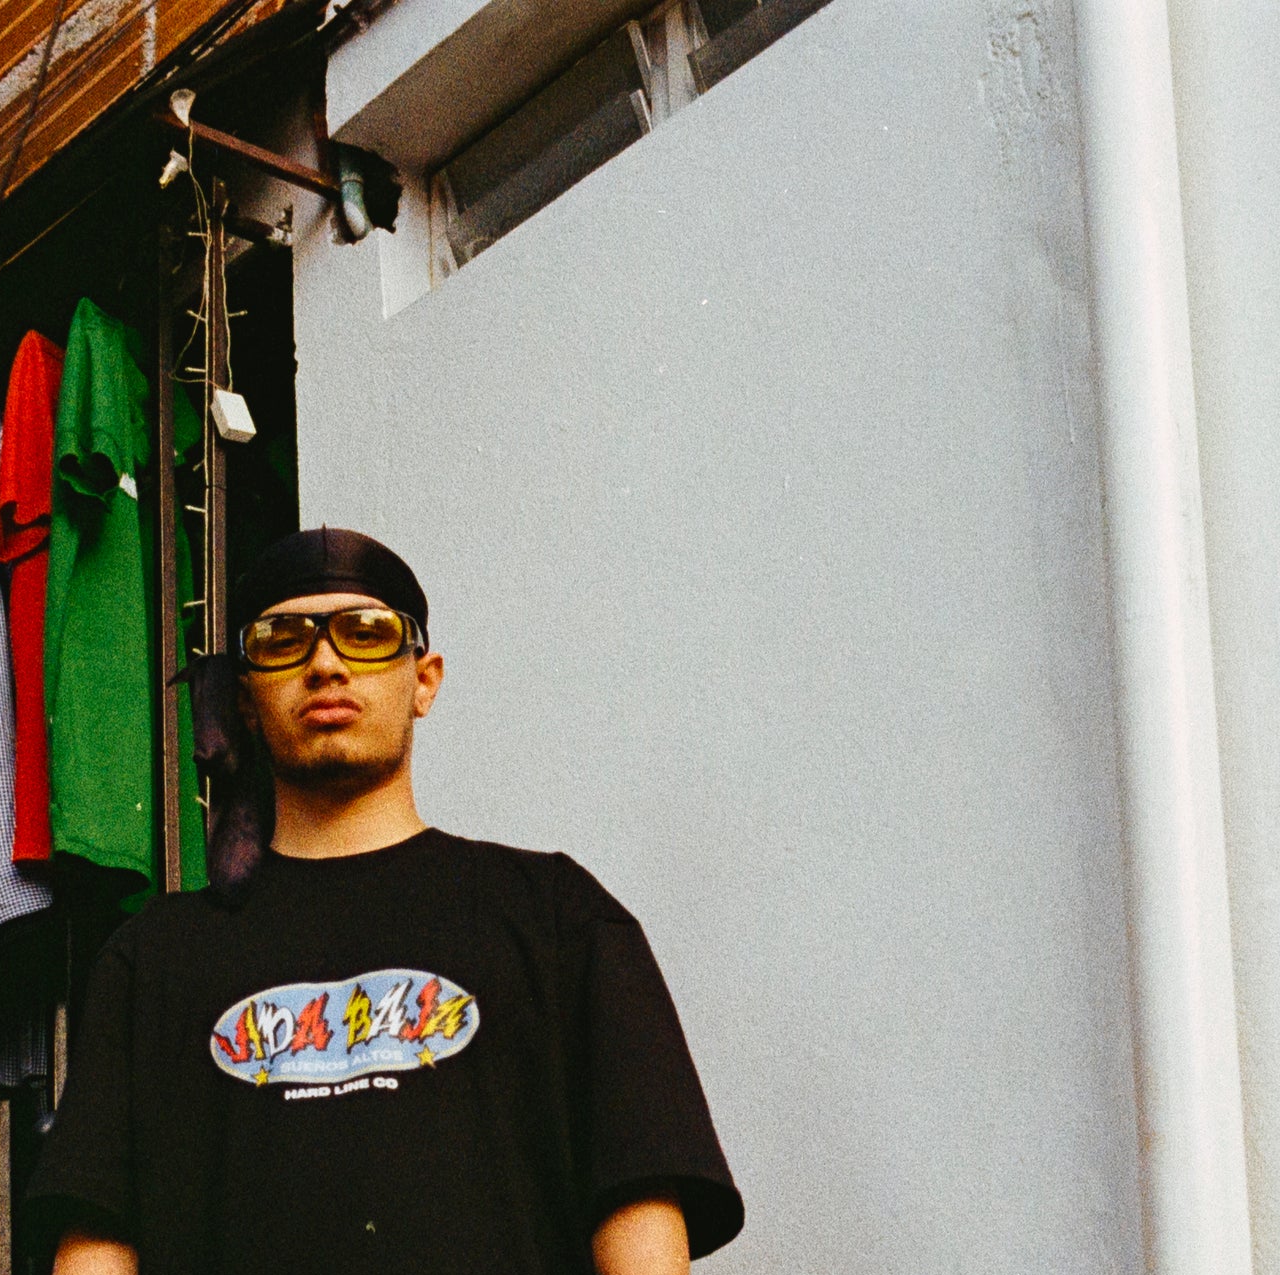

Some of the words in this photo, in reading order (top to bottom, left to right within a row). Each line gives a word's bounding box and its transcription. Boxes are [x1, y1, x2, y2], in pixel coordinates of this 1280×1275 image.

[342, 977, 476, 1054] BAJA
[284, 1086, 331, 1100] HARD
[333, 1078, 370, 1095] LINE
[372, 1076, 399, 1090] CO
